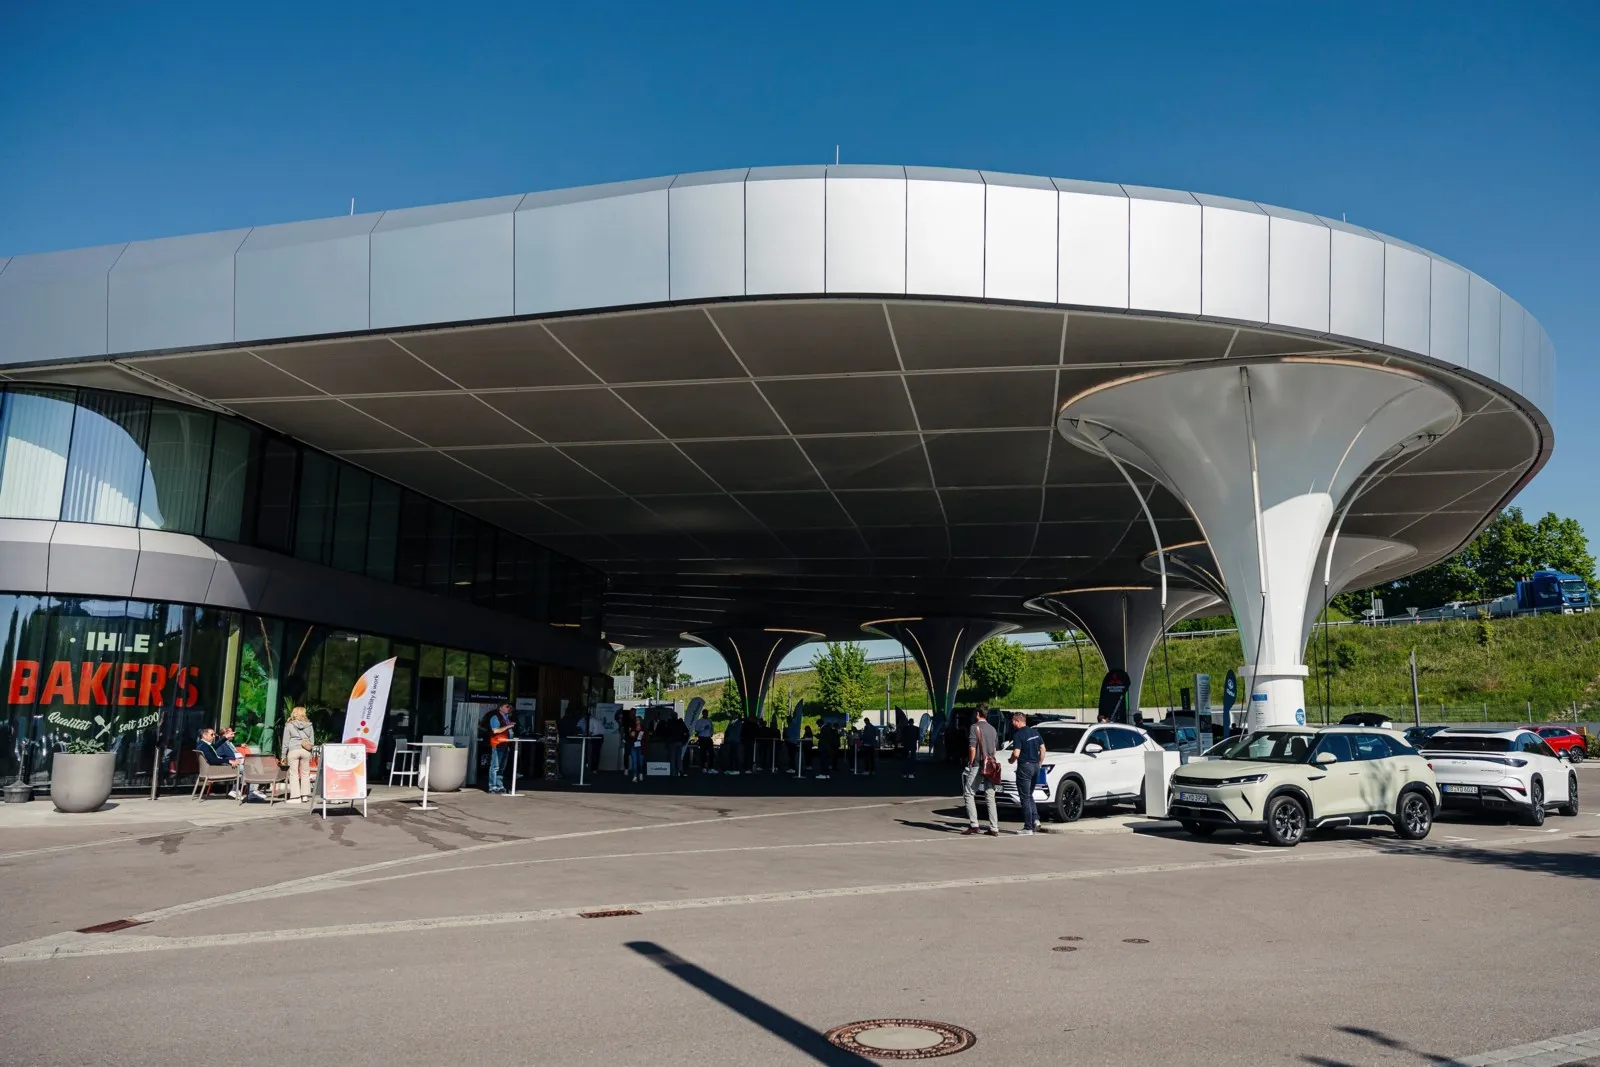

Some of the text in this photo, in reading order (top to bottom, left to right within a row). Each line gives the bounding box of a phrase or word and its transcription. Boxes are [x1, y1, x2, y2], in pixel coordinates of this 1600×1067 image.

[86, 631, 151, 653] IHLE
[8, 660, 199, 708] BAKER'S
[366, 695, 376, 720] mobility
[47, 711, 160, 733] Qualität seit 1890
